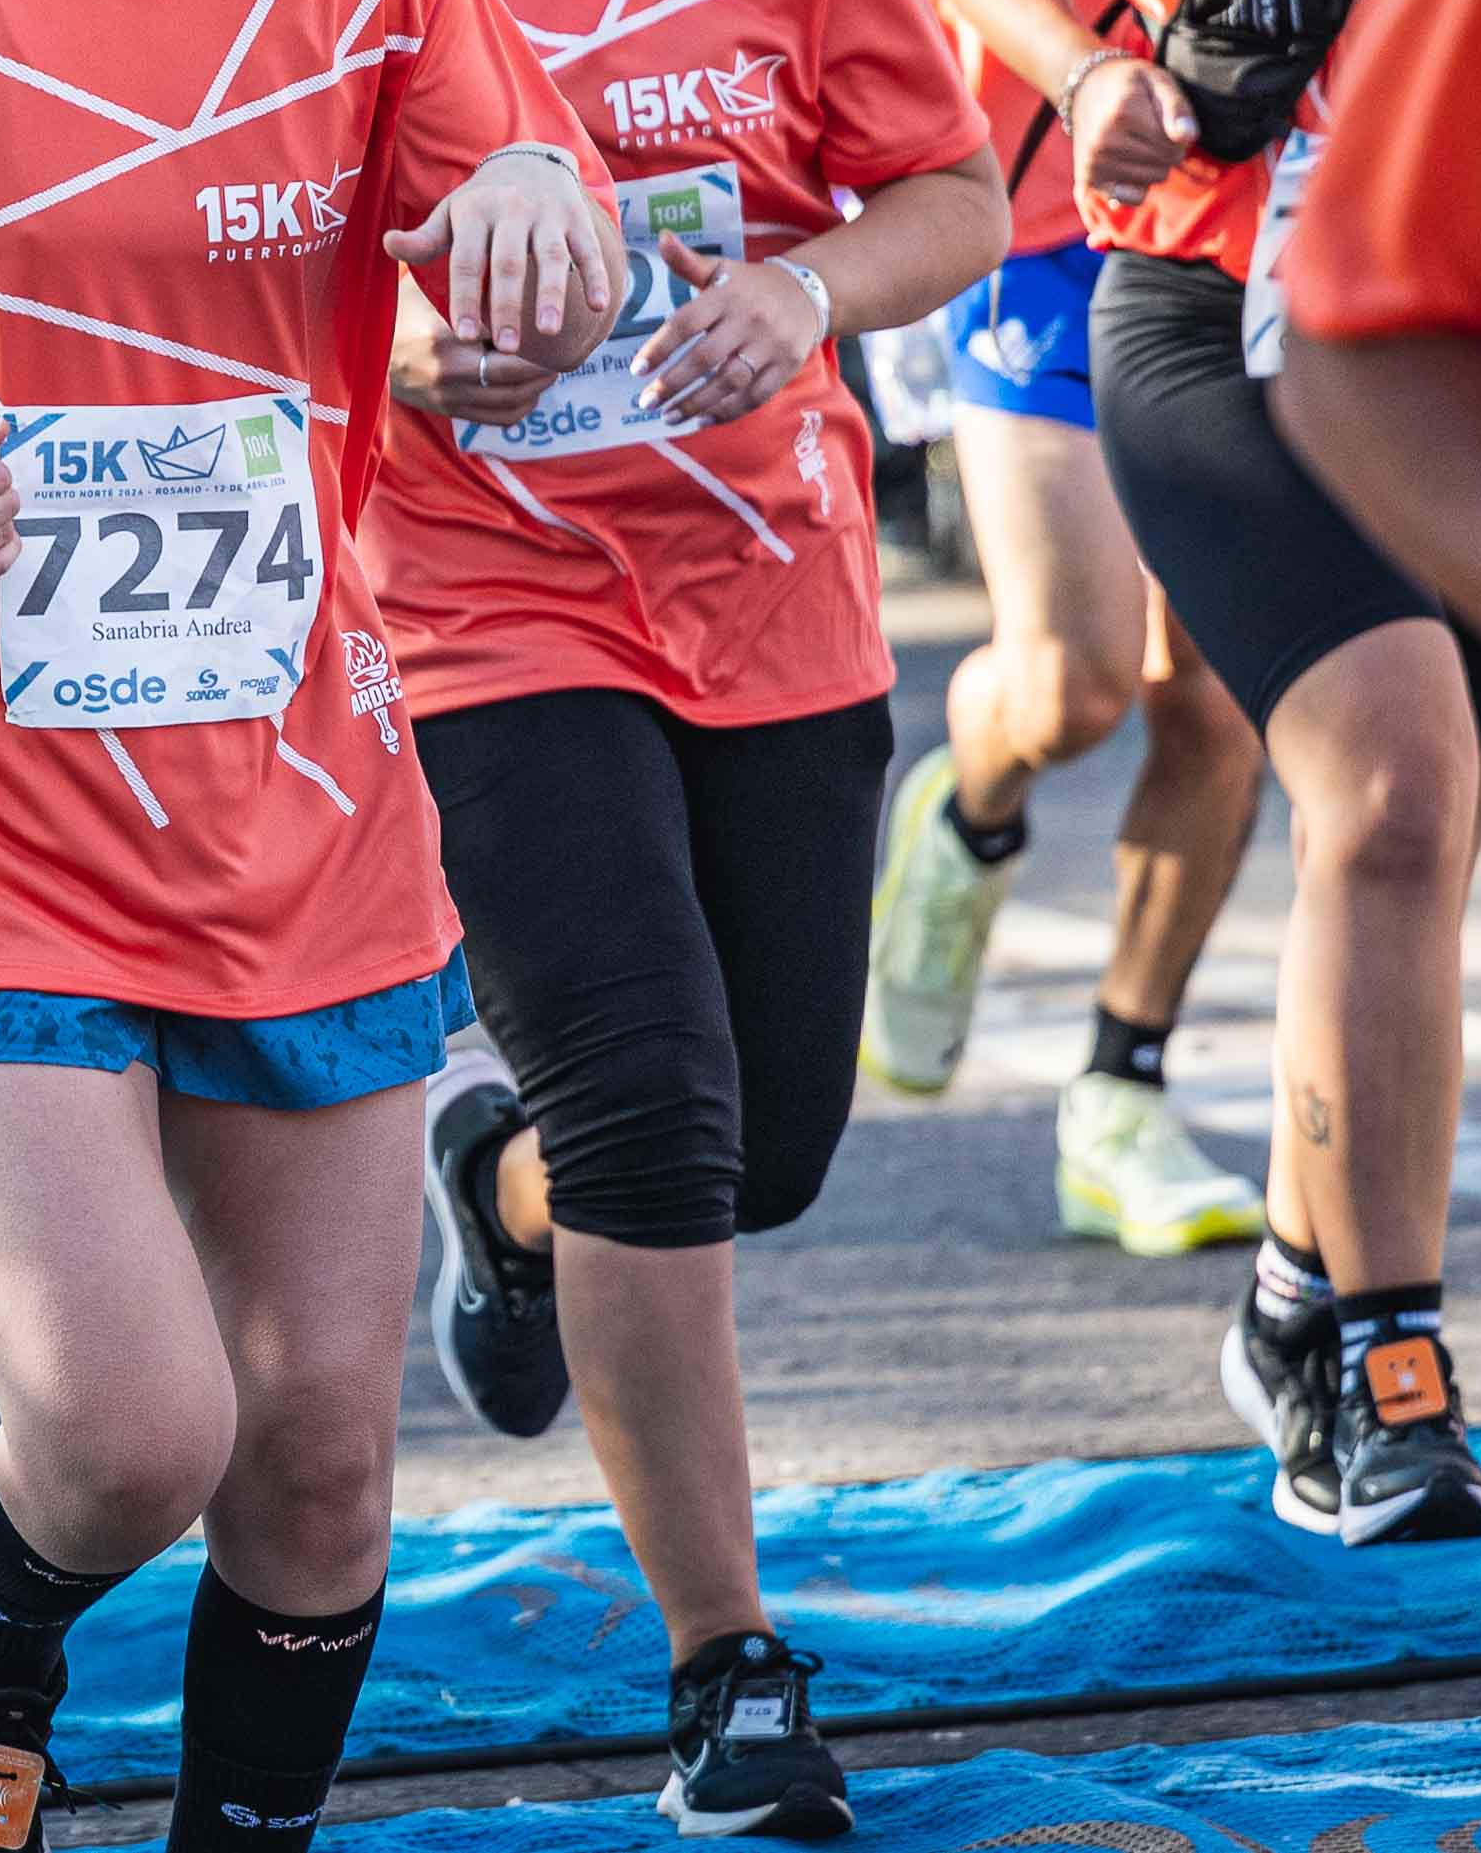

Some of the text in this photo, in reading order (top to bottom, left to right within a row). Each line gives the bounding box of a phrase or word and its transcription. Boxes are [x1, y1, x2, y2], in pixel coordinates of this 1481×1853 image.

[603, 68, 711, 133] 15K
[618, 126, 713, 152] PUERTO
[196, 181, 304, 244] 15K
[652, 201, 697, 225] 10K
[208, 243, 304, 264] PUERTO
[35, 434, 275, 485] 15K 10K
[34, 489, 76, 499] PUERTO
[79, 489, 114, 498] NORTE
[155, 485, 202, 496] ROSARIO
[12, 501, 314, 617] 7274
[92, 615, 253, 642] Sanabria Andrea
[53, 666, 167, 714] osde
[350, 676, 404, 718] ARDEC
